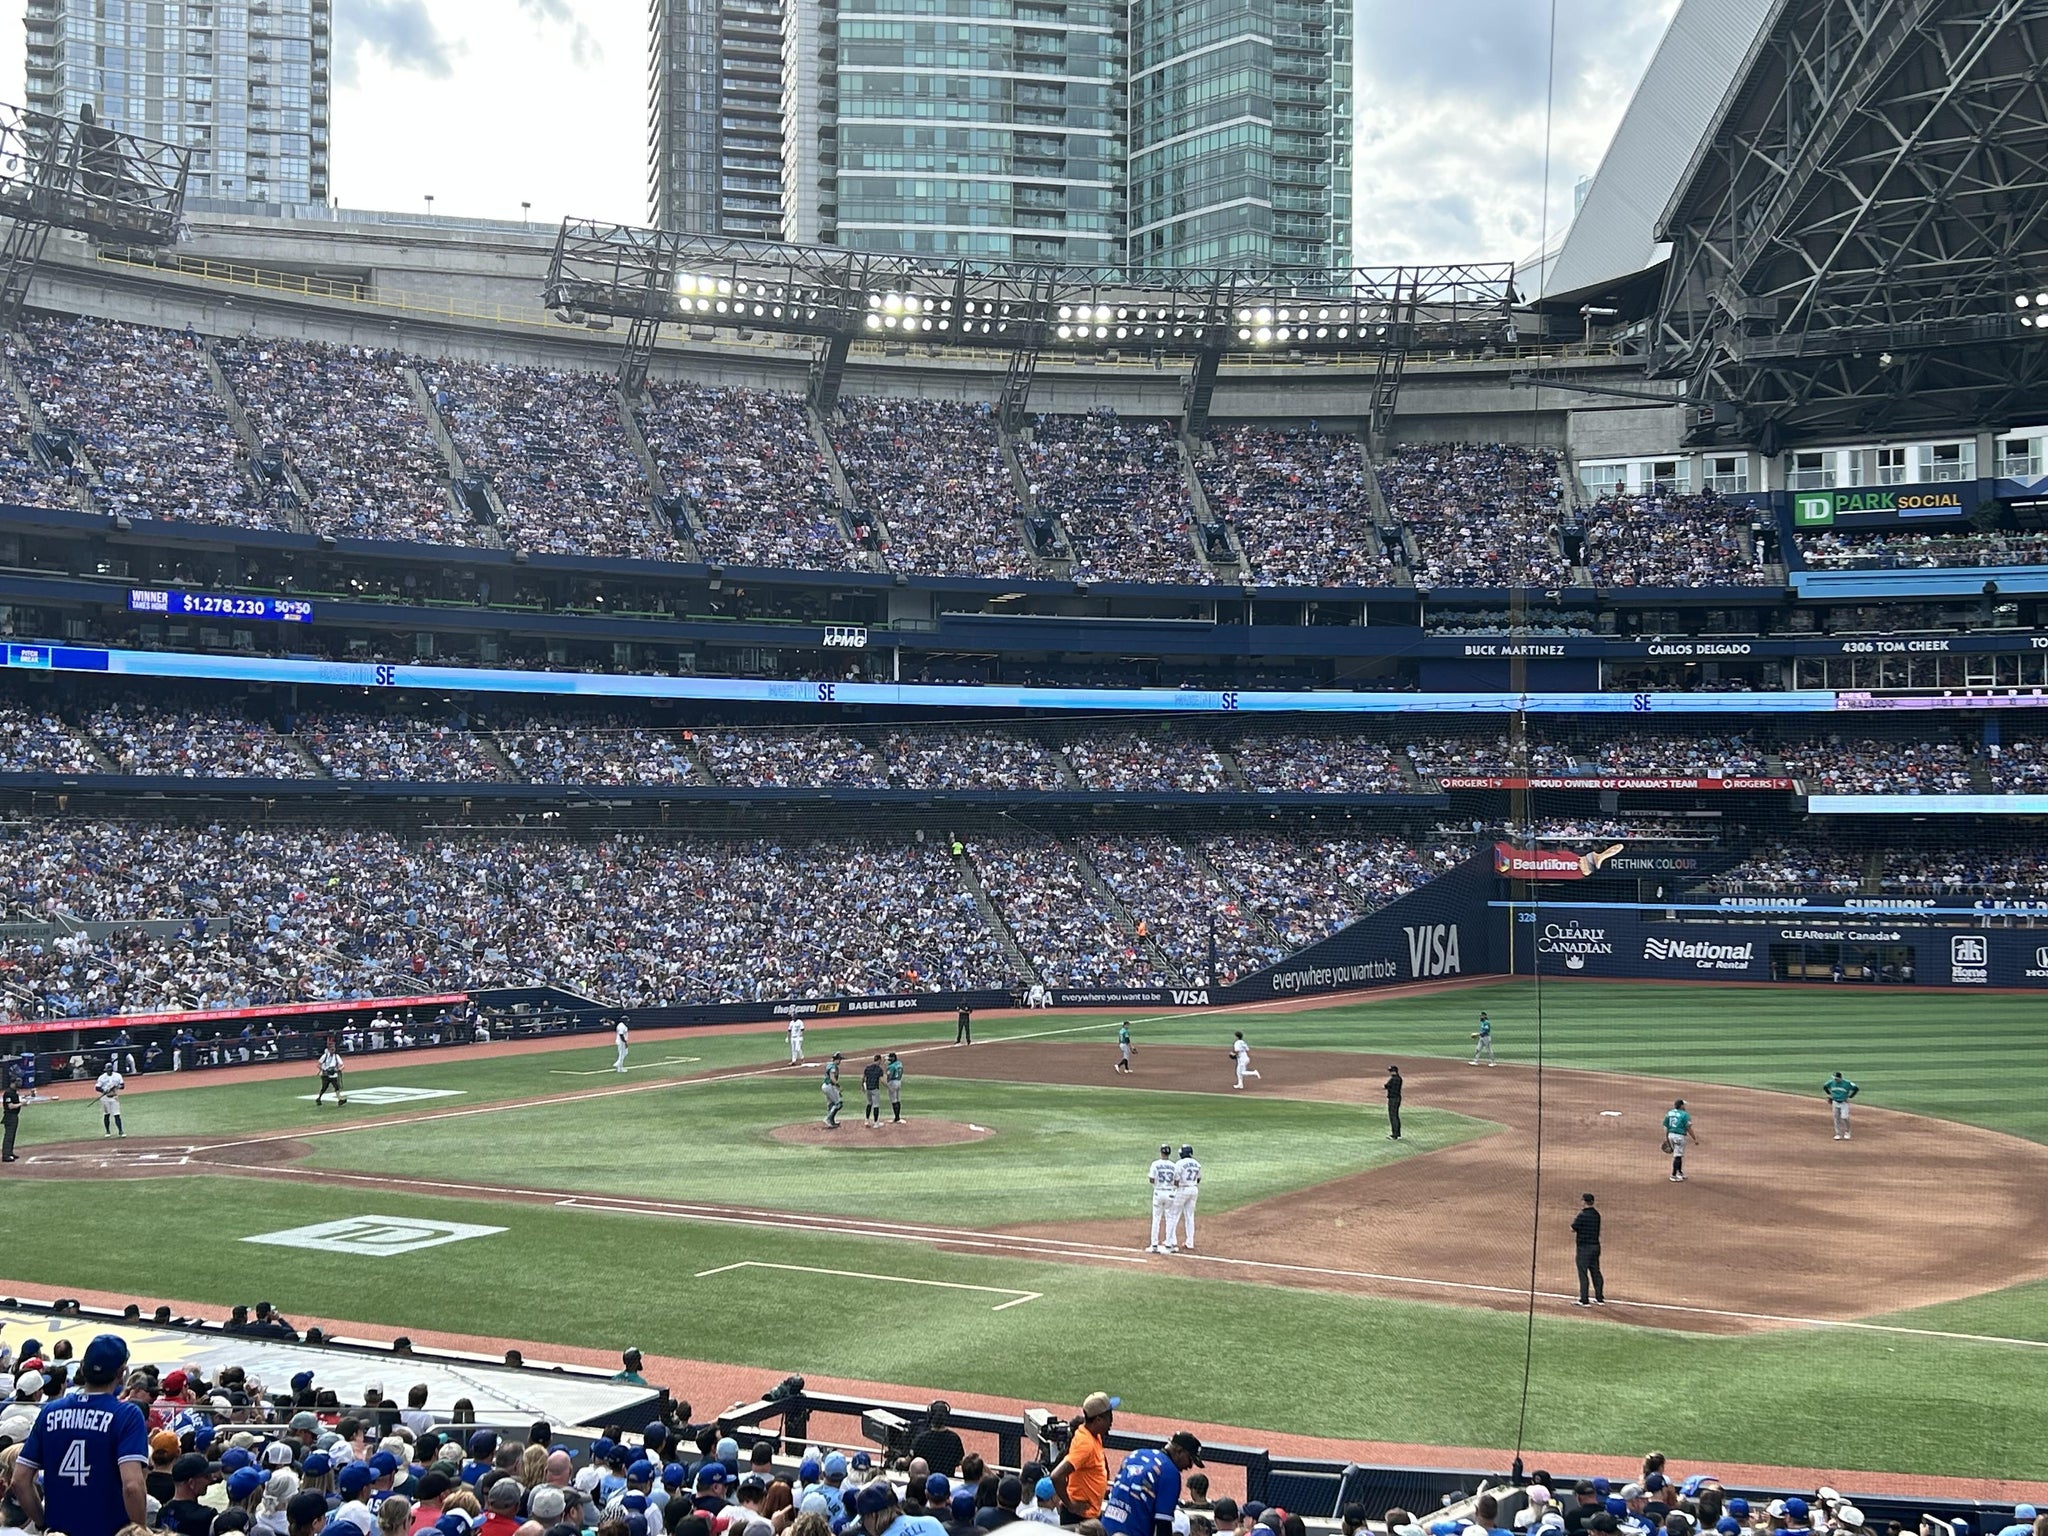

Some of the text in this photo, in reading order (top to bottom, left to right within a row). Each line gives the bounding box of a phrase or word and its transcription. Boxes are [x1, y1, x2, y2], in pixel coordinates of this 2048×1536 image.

[1798, 492, 1962, 520] TD PARK SOCIAL
[132, 590, 168, 602] WINNER
[823, 634, 866, 648] KPMG
[1842, 640, 1949, 652] 4306 TOM CHEEK
[1464, 645, 1565, 656] BUCK MARTINEZ
[1648, 643, 1751, 655] CARLOS DELGADO
[1451, 779, 1488, 788] ROGERS
[1528, 779, 1698, 789] PROUD OWNER OF CANADA'S TEAM
[1733, 779, 1772, 789] ROGERS
[1513, 858, 1579, 871] BeautiTone
[1611, 858, 1698, 870] RETHINK COLOUR
[1545, 924, 1605, 942] CLEARLY
[1781, 930, 1890, 941] CLEAResult Canada
[1403, 924, 1461, 977] VISA
[1538, 937, 1612, 953] CANADIAN
[1696, 960, 1749, 970] Car Rental
[1272, 957, 1397, 992] everywhere you want to be
[1952, 966, 1988, 977] Home
[1061, 994, 1105, 1003] everywhere
[1105, 994, 1121, 1003] you
[1122, 993, 1141, 1001] want
[1142, 993, 1150, 1001] to
[1150, 993, 1161, 1001] be
[1169, 990, 1209, 1005] VISA
[849, 1002, 896, 1011] BASELINE
[897, 999, 918, 1009] BOX
[46, 1408, 114, 1433] SPRINGER
[58, 1439, 91, 1487] 4
